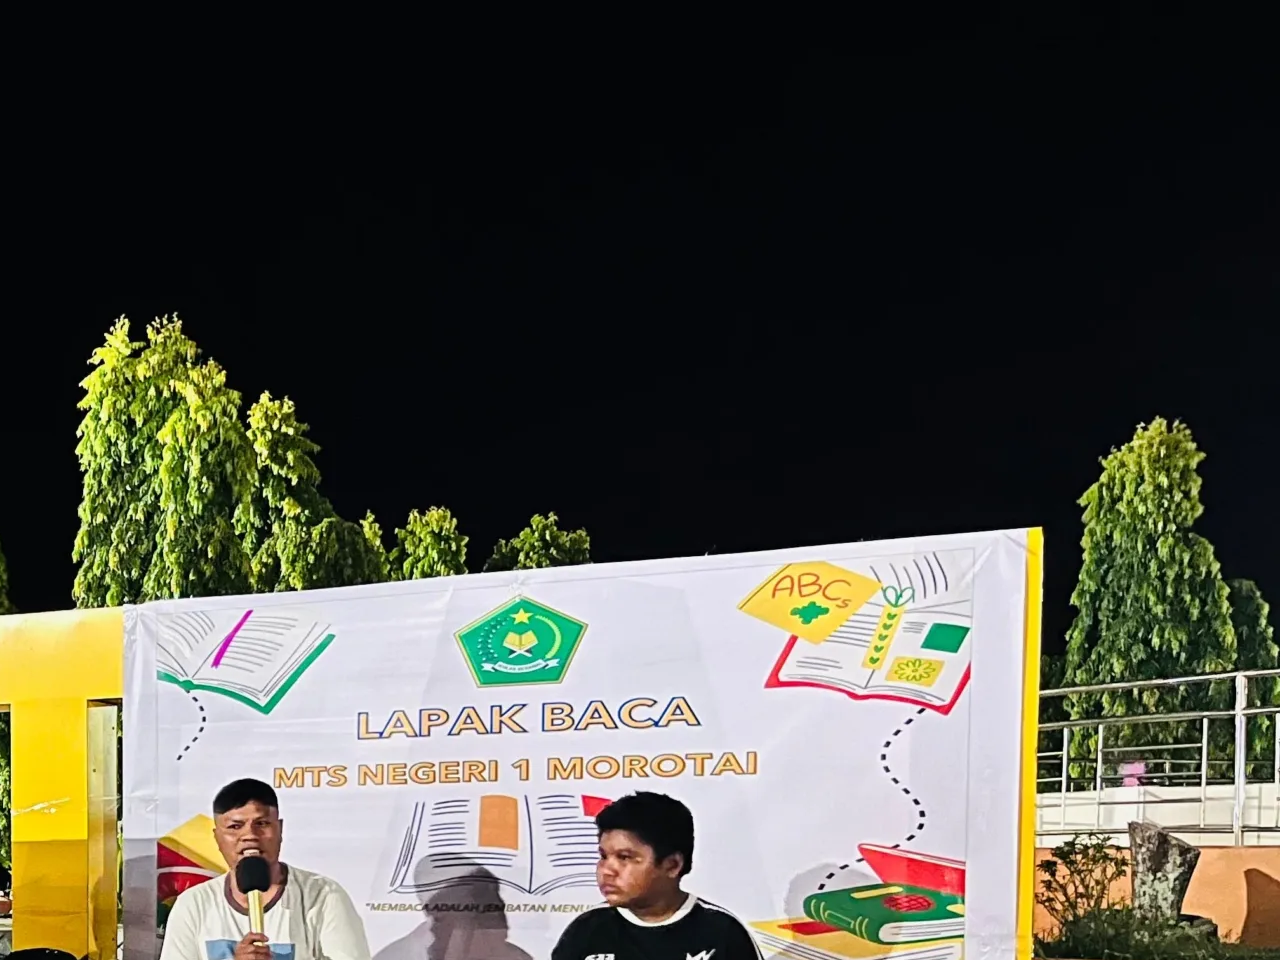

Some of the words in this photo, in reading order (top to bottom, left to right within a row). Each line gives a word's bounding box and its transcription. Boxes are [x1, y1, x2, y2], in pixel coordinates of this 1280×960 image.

[771, 572, 852, 608] ABCs
[357, 703, 528, 740] LAPAK
[542, 696, 701, 732] BACA
[273, 765, 348, 788] MTS
[358, 760, 498, 786] NEGERI
[511, 758, 530, 781] 1
[547, 751, 757, 780] MOROTAI
[478, 903, 547, 913] JEMBATAN
